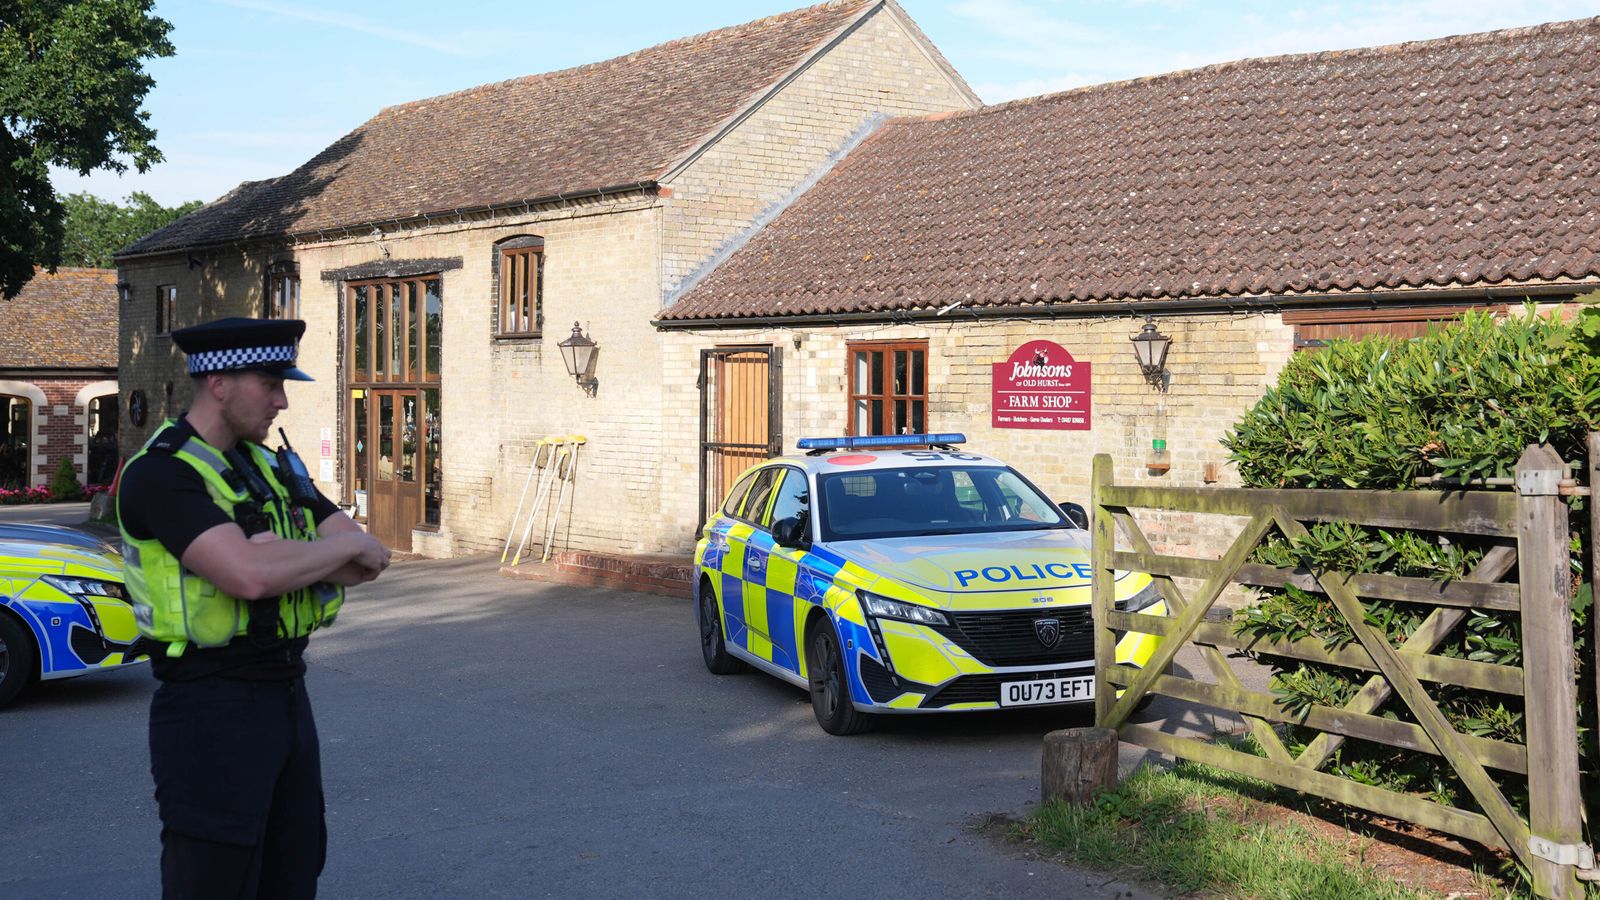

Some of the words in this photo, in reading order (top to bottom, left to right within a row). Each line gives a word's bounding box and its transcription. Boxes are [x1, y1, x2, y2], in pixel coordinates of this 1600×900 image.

[1009, 361, 1072, 381] Johnsons
[1009, 395, 1039, 408] FARM
[1042, 396, 1072, 408] SHOP
[954, 563, 1092, 587] POLICE
[1009, 683, 1056, 702] OU73
[1060, 679, 1093, 698] EFT
